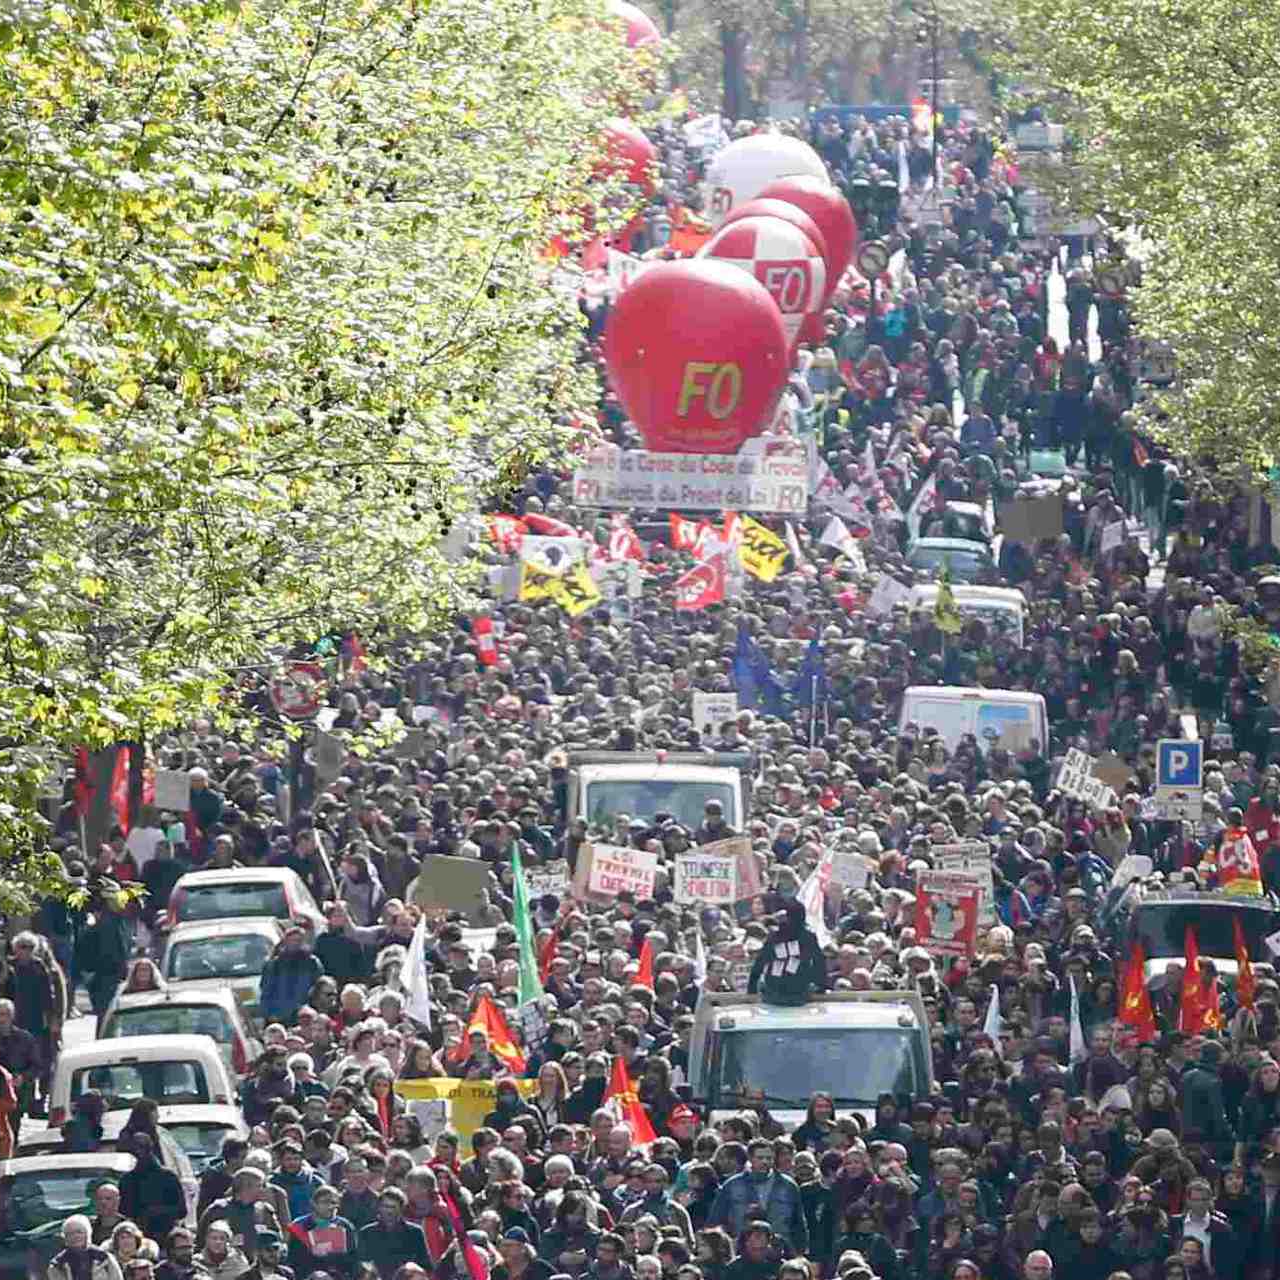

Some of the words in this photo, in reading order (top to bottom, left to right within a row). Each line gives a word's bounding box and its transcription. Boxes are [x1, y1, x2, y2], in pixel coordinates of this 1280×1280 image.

[766, 265, 804, 313] FO
[677, 361, 742, 421] FO
[1169, 750, 1189, 778] P
